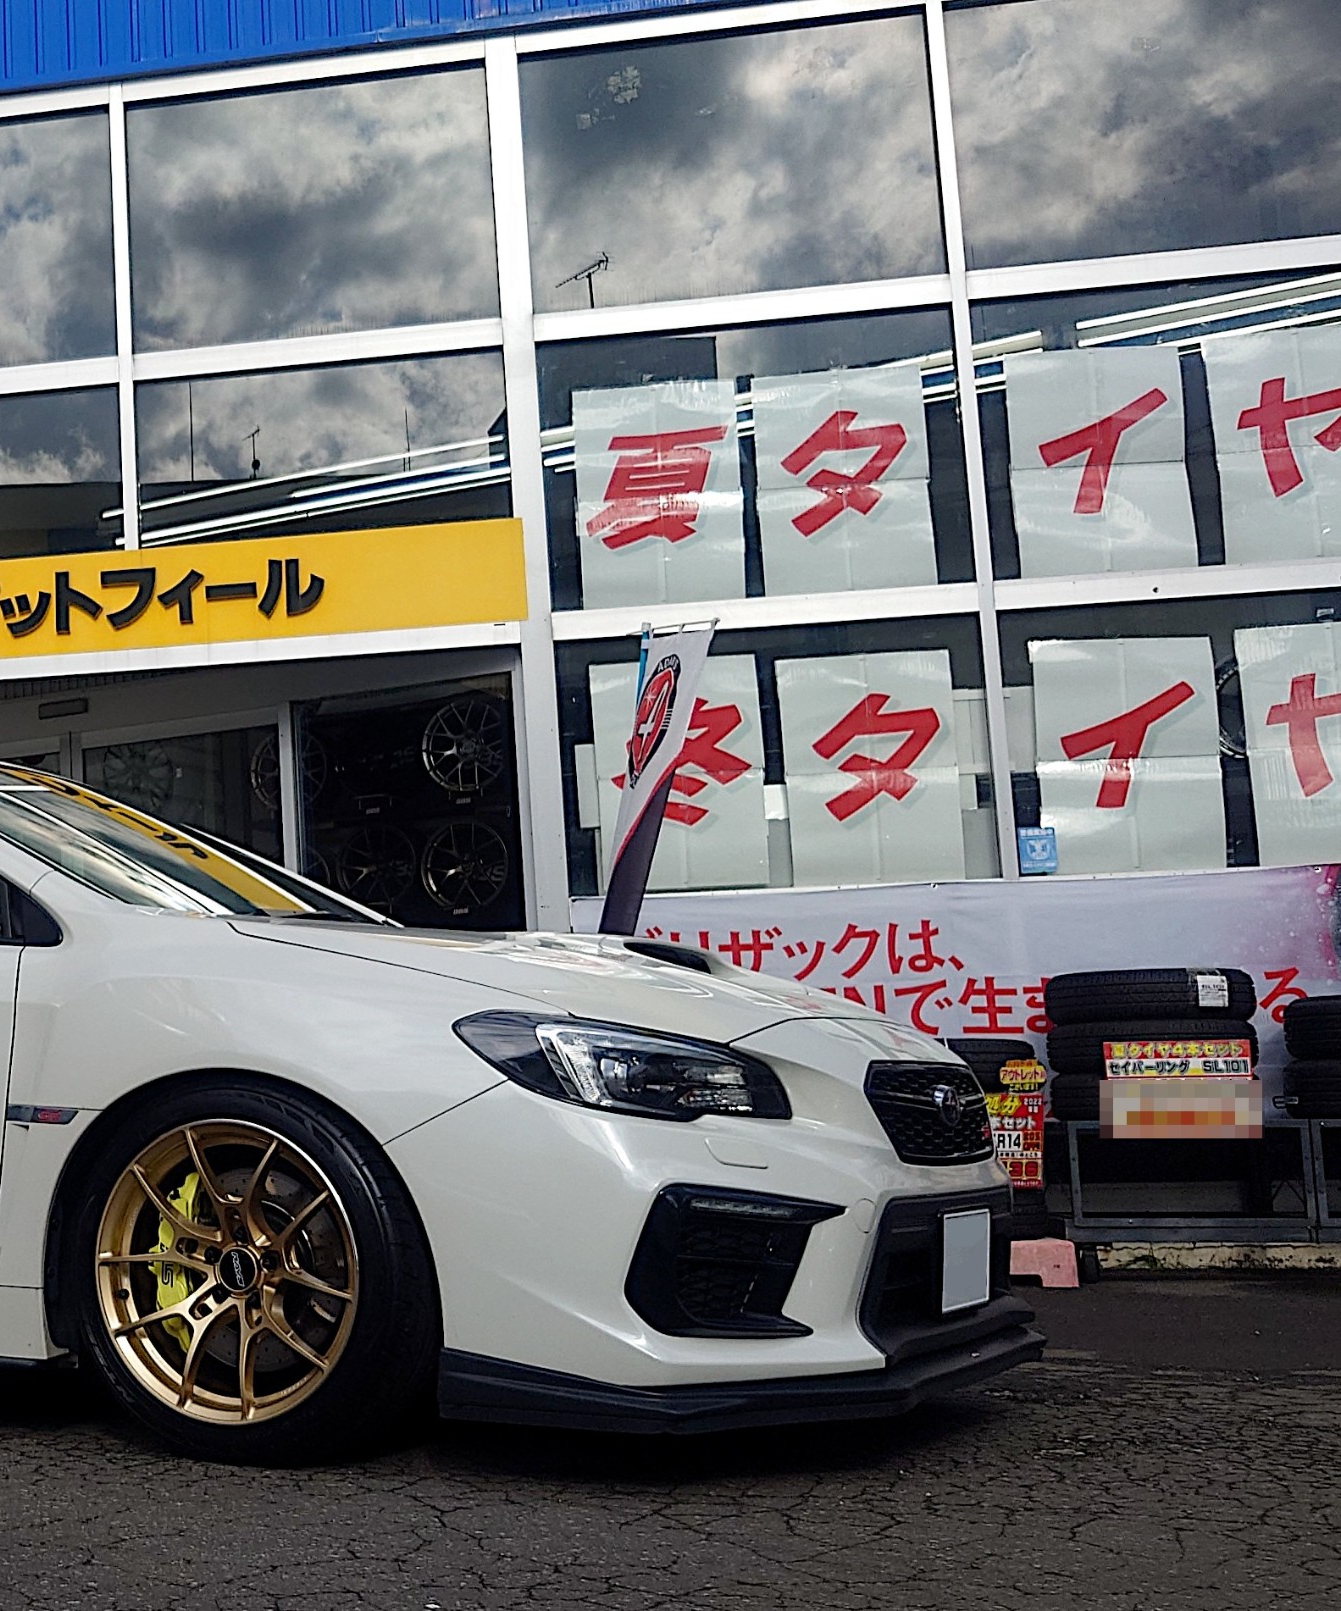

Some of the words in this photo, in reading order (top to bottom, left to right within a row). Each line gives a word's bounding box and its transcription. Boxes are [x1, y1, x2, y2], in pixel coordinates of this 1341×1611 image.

[644, 919, 965, 982] ザックは、
[1202, 1059, 1250, 1074] SL101
